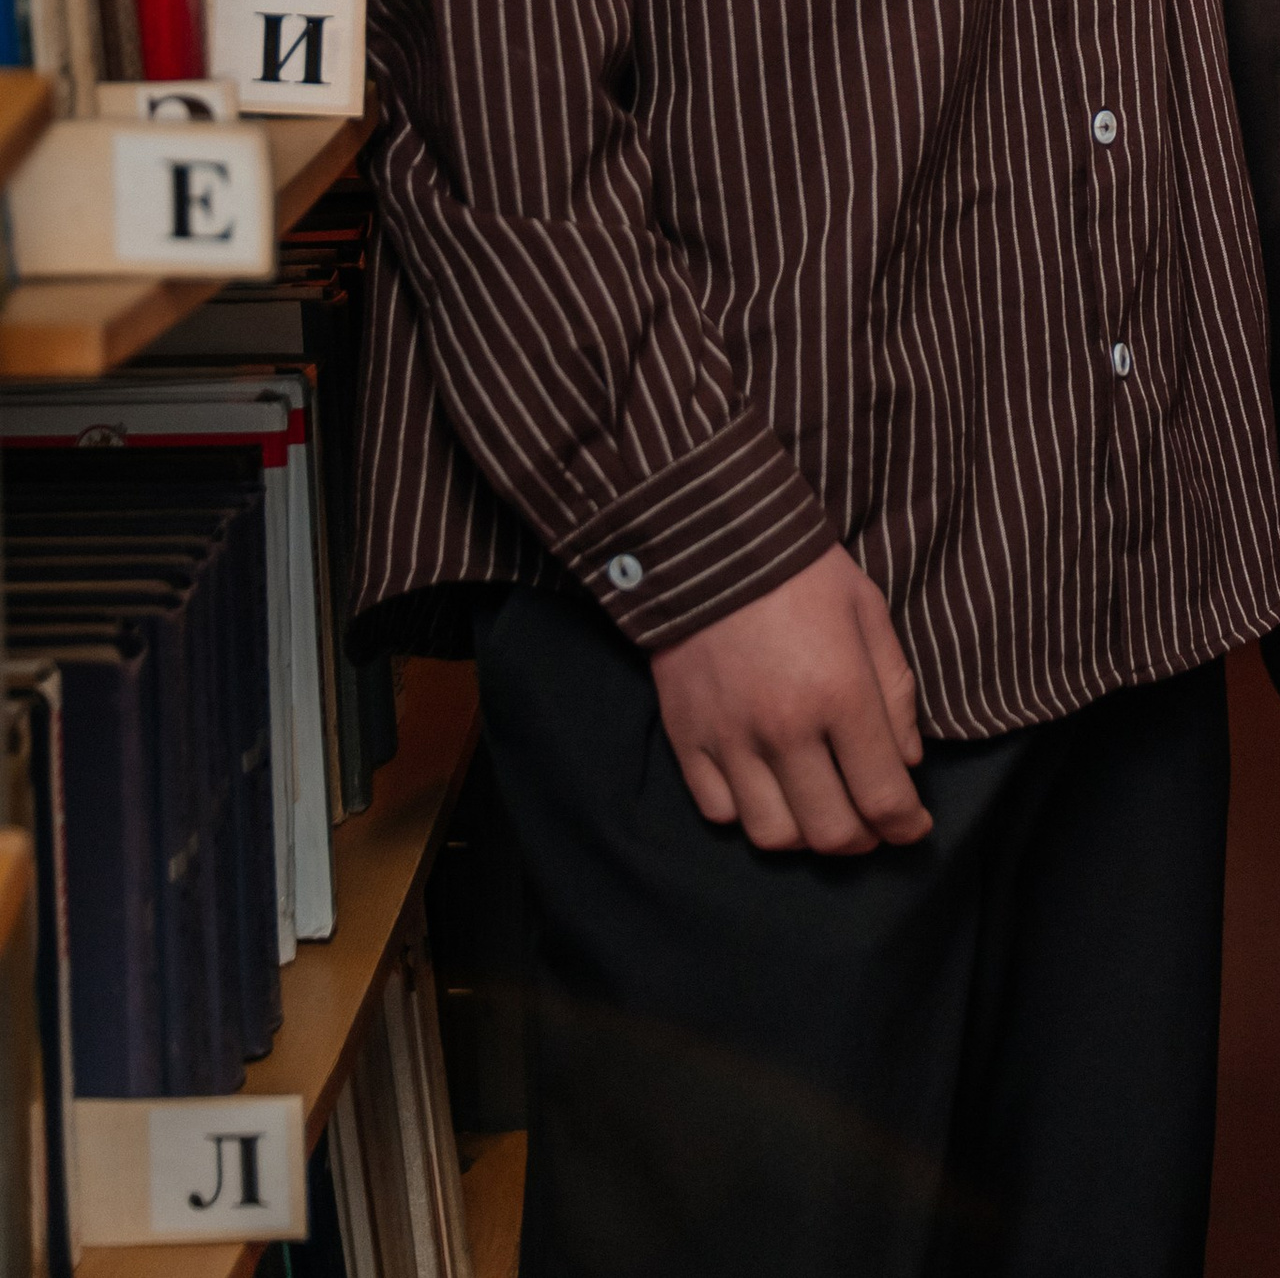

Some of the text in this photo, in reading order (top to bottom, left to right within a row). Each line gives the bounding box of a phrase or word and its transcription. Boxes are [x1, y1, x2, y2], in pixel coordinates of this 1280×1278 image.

[256, 10, 333, 86] И
[165, 158, 234, 243] Е
[188, 1131, 269, 1211] Л
